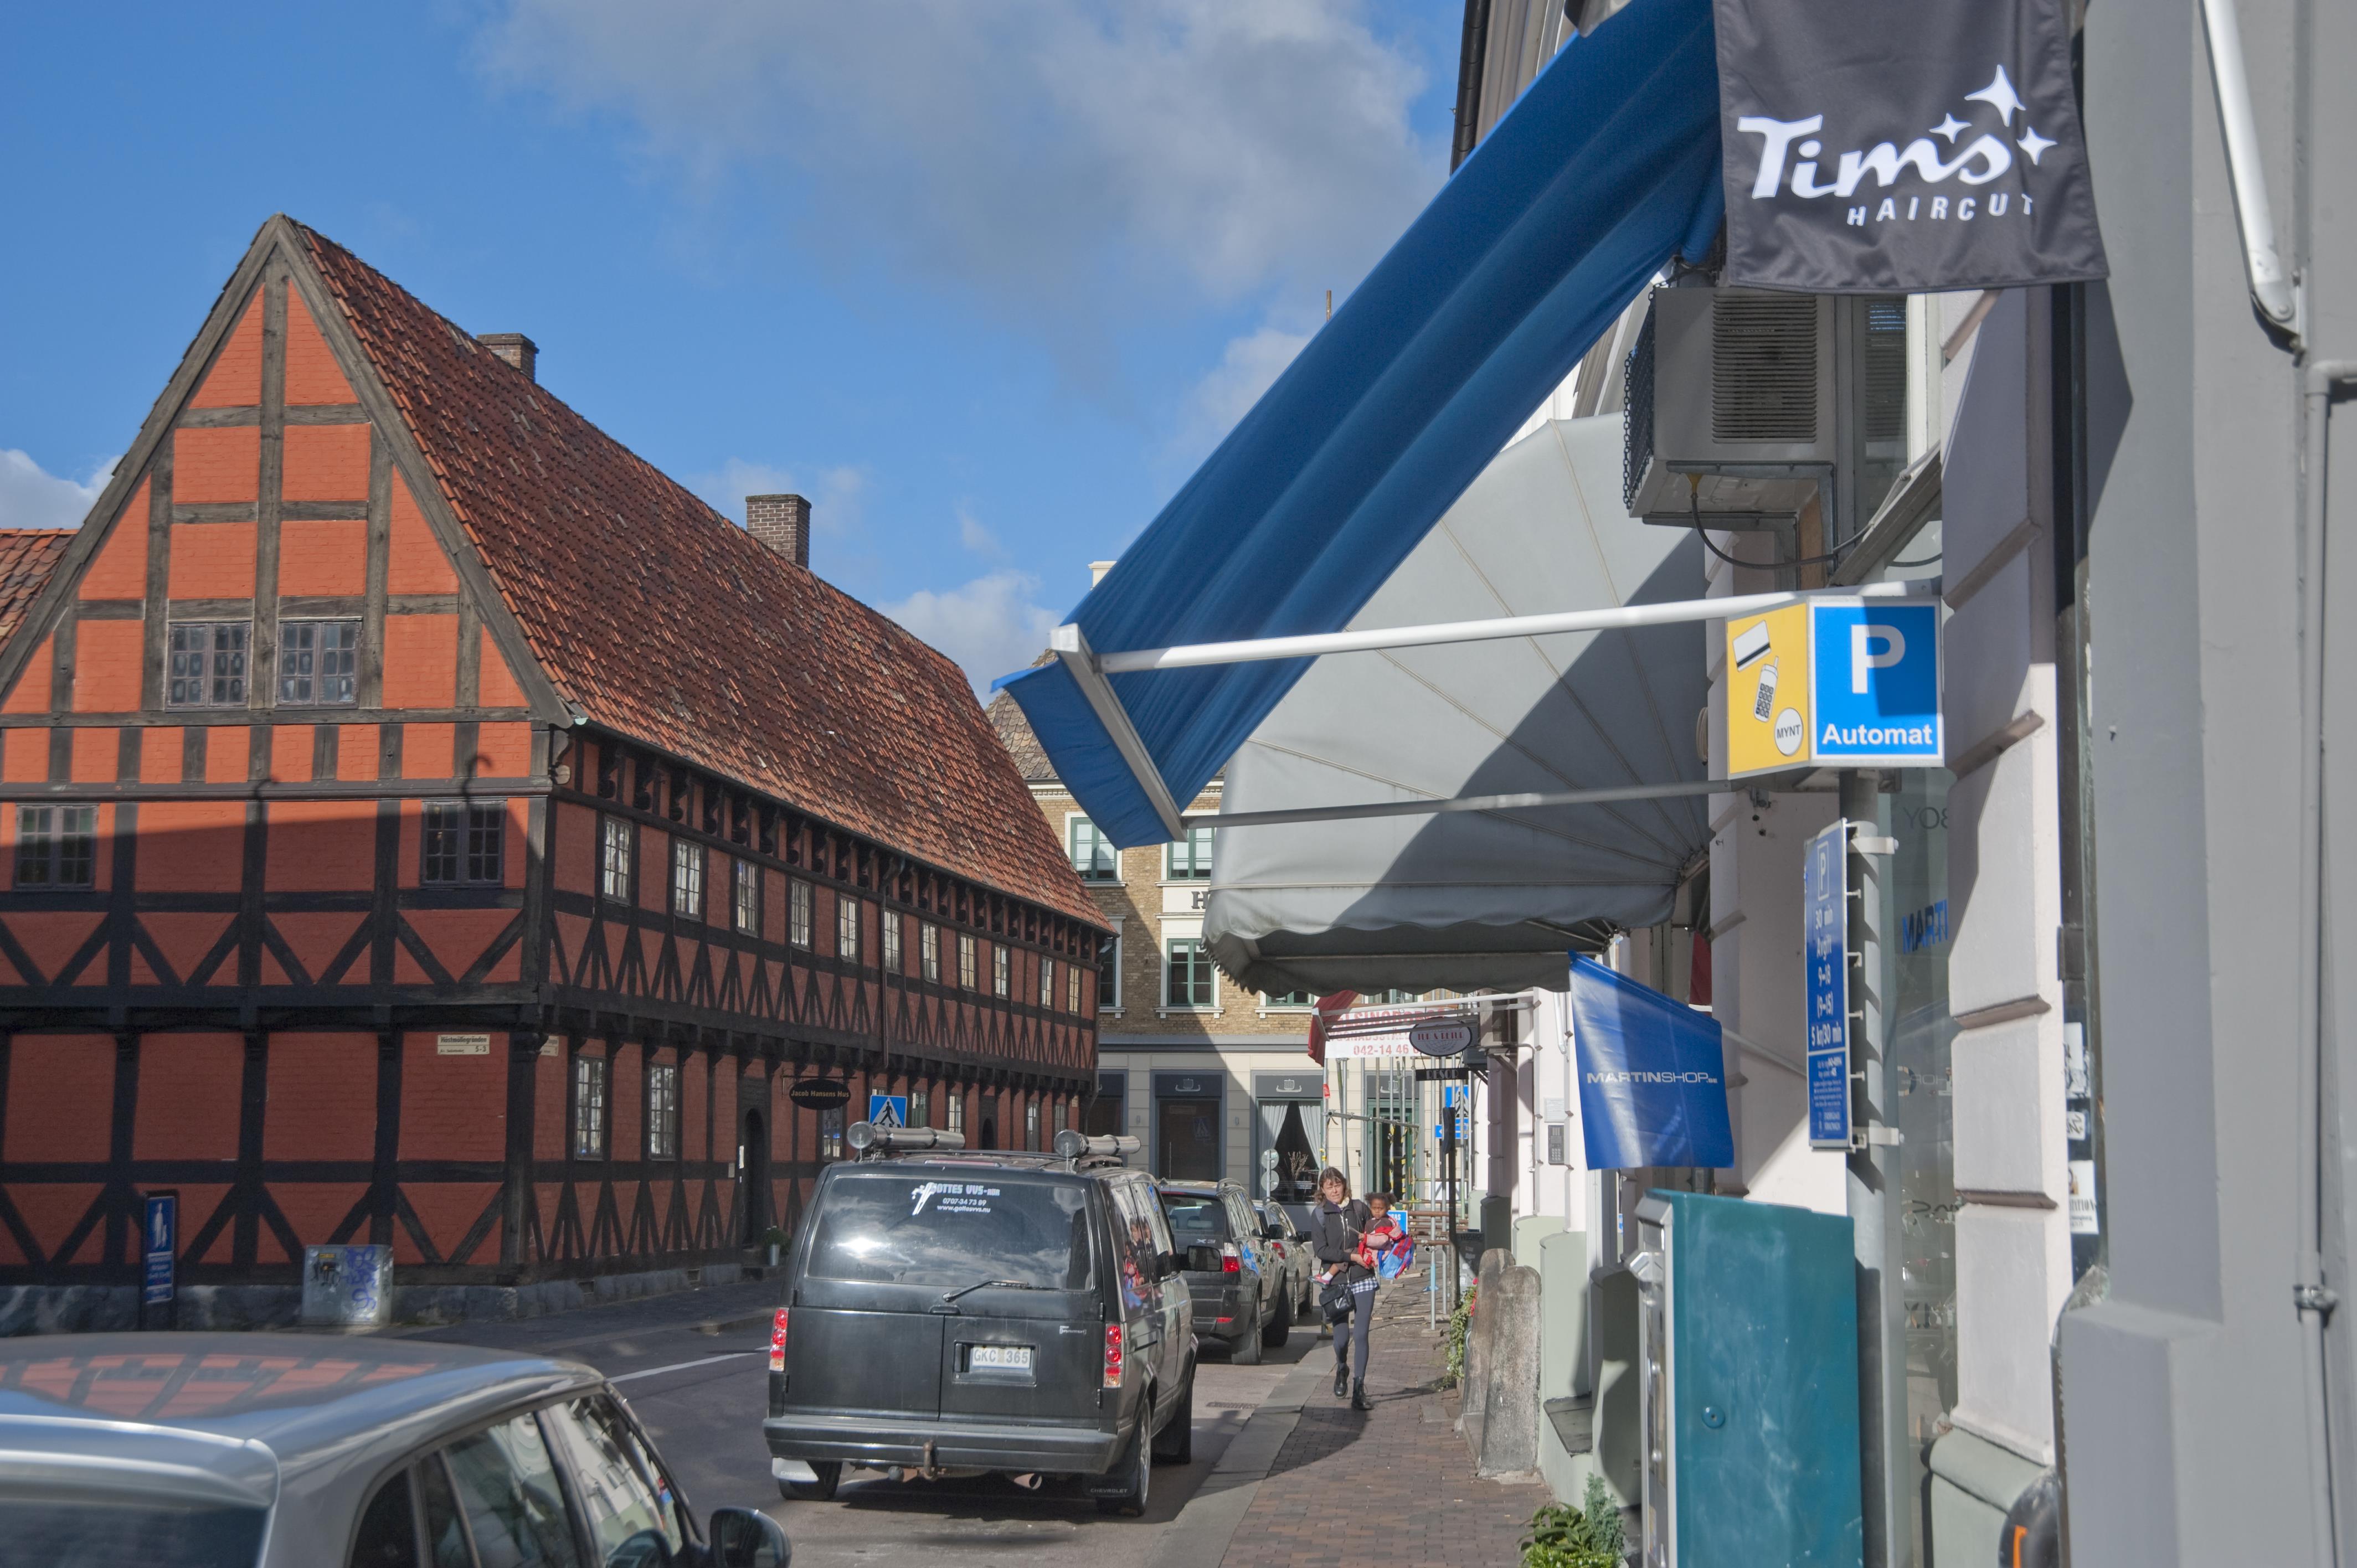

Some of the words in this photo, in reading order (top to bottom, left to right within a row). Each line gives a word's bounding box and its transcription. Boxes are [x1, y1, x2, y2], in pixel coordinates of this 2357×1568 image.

[1737, 115, 2011, 199] Tims
[1847, 193, 2034, 226] HAIRCUT
[1851, 624, 1906, 694] P
[1777, 724, 1801, 739] MYNT
[1822, 723, 1933, 745] Automat
[1811, 1026, 1815, 1047] 5
[1353, 1045, 1392, 1055] 042-14
[1396, 1044, 1408, 1054] 46
[974, 1349, 997, 1363] GKC
[1006, 1350, 1029, 1364] 365
